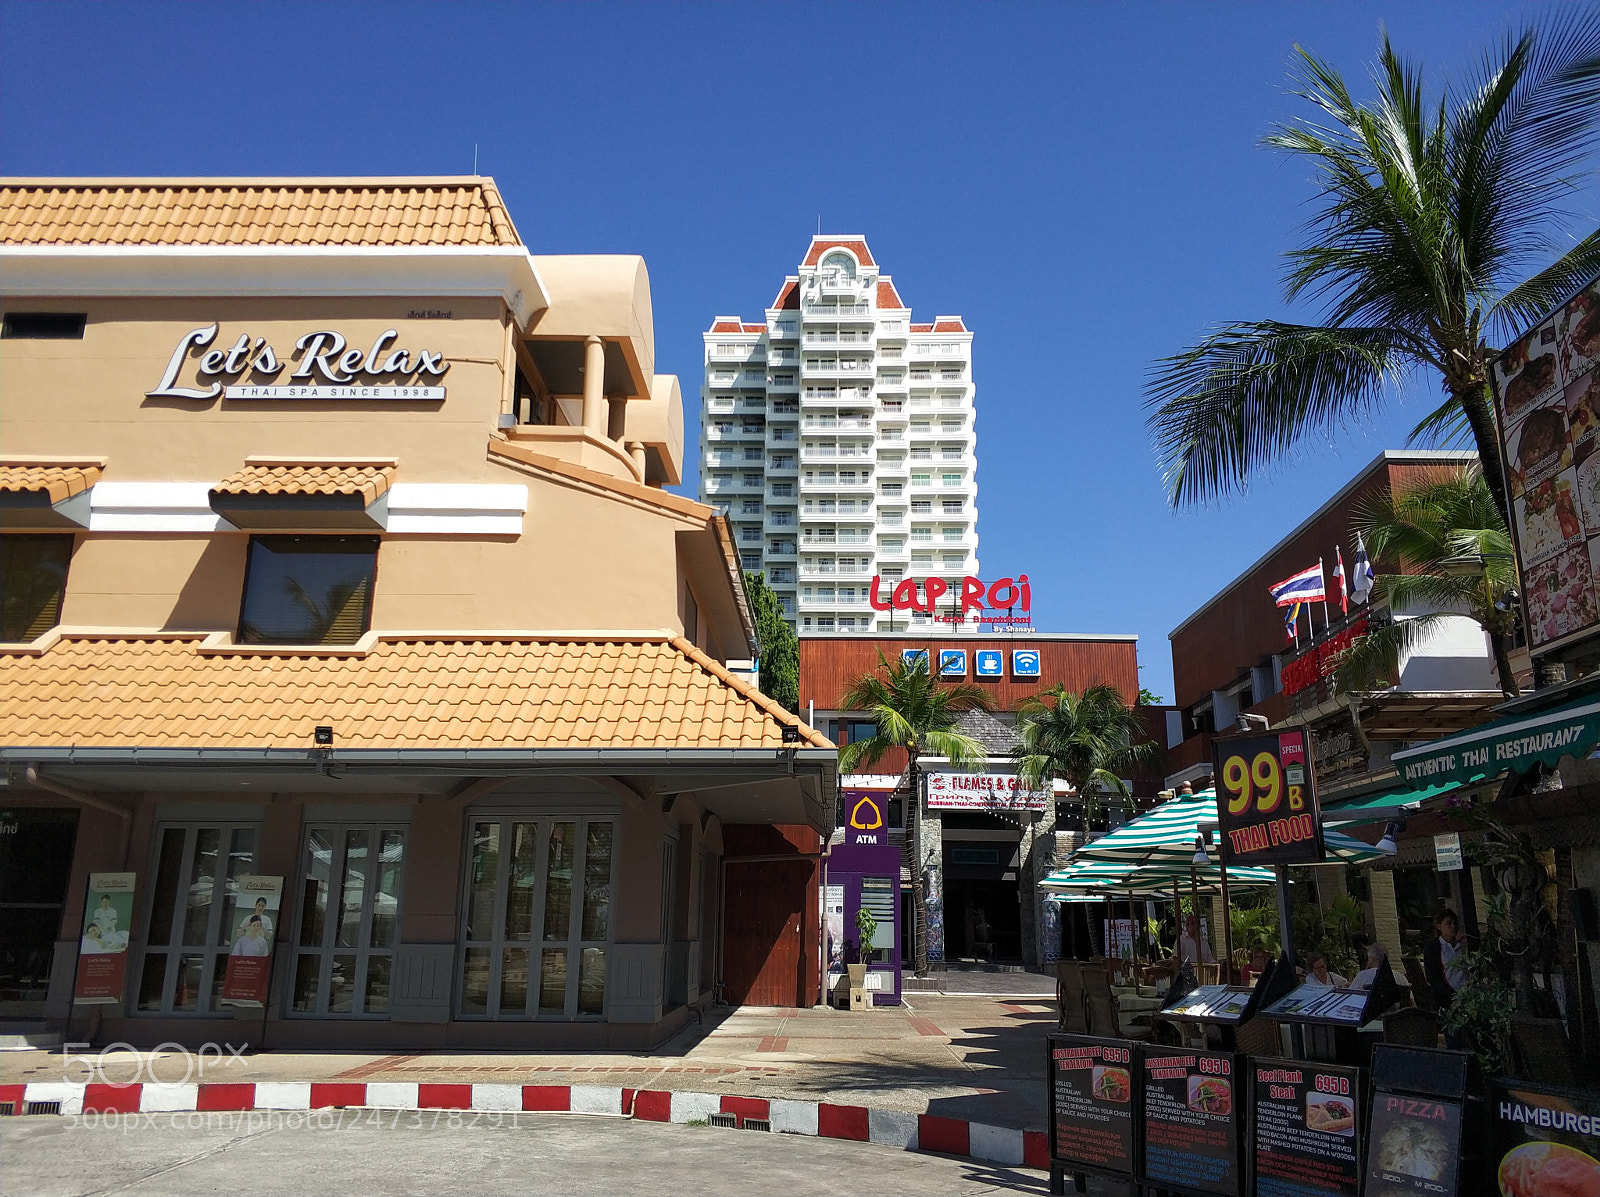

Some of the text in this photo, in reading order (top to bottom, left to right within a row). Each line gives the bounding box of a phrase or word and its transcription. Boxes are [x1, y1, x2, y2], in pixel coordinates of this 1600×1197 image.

[145, 321, 451, 399] Let's Relax
[240, 388, 431, 397] THAI SPA SINCE 1998
[1005, 625, 1036, 634] Shanaya
[1404, 725, 1584, 780] AUTHENTIC THAI RESTAURANT
[952, 778, 992, 790] FLAMES
[998, 778, 1004, 790] &
[1223, 752, 1284, 816] 99
[856, 835, 878, 844] ATM
[1228, 813, 1314, 854] THAI FOOD
[1052, 1046, 1102, 1060] AUSTRALIAN BEEF
[1102, 1047, 1130, 1063] 695 B
[1058, 1058, 1094, 1070] TENDERLOIN
[1144, 1056, 1196, 1069] AUSTRALIAN BEEF
[1200, 1057, 1230, 1076] 695 B
[1151, 1068, 1188, 1080] TENDERLOIN
[1256, 1069, 1304, 1084] Beef Plank
[1146, 1084, 1164, 1092] GRILLED
[1315, 1074, 1350, 1094] 695 B
[1146, 1092, 1174, 1100] AUSTRALIAN
[1270, 1084, 1296, 1100] Steak
[1156, 1100, 1186, 1110] TENDERLOIN
[1257, 1101, 1286, 1110] AUSTRALIAN
[1386, 1098, 1446, 1120] PIZZA
[1152, 1112, 1168, 1120] SAUCE
[1180, 1116, 1206, 1126] POTATOES
[1162, 1106, 1180, 1116] SERVED
[1196, 1112, 1210, 1120] YOUR
[1210, 1114, 1230, 1122] CHOICE
[1257, 1108, 1303, 1120] TENDERLOIN PLANK
[1500, 1102, 1600, 1136] HAMBURGE
[1257, 1122, 1345, 1144] AUSTRALIAN BEEF TENDERLOIN WITH
[1270, 1138, 1290, 1148] MASHED
[1292, 1142, 1316, 1154] POTATOES
[1330, 1151, 1356, 1162] WOODEN
[1271, 1132, 1288, 1141] BACON
[1288, 1135, 1299, 1143] AND
[1330, 1144, 1352, 1154] SERVED
[1414, 1180, 1422, 1188] M
